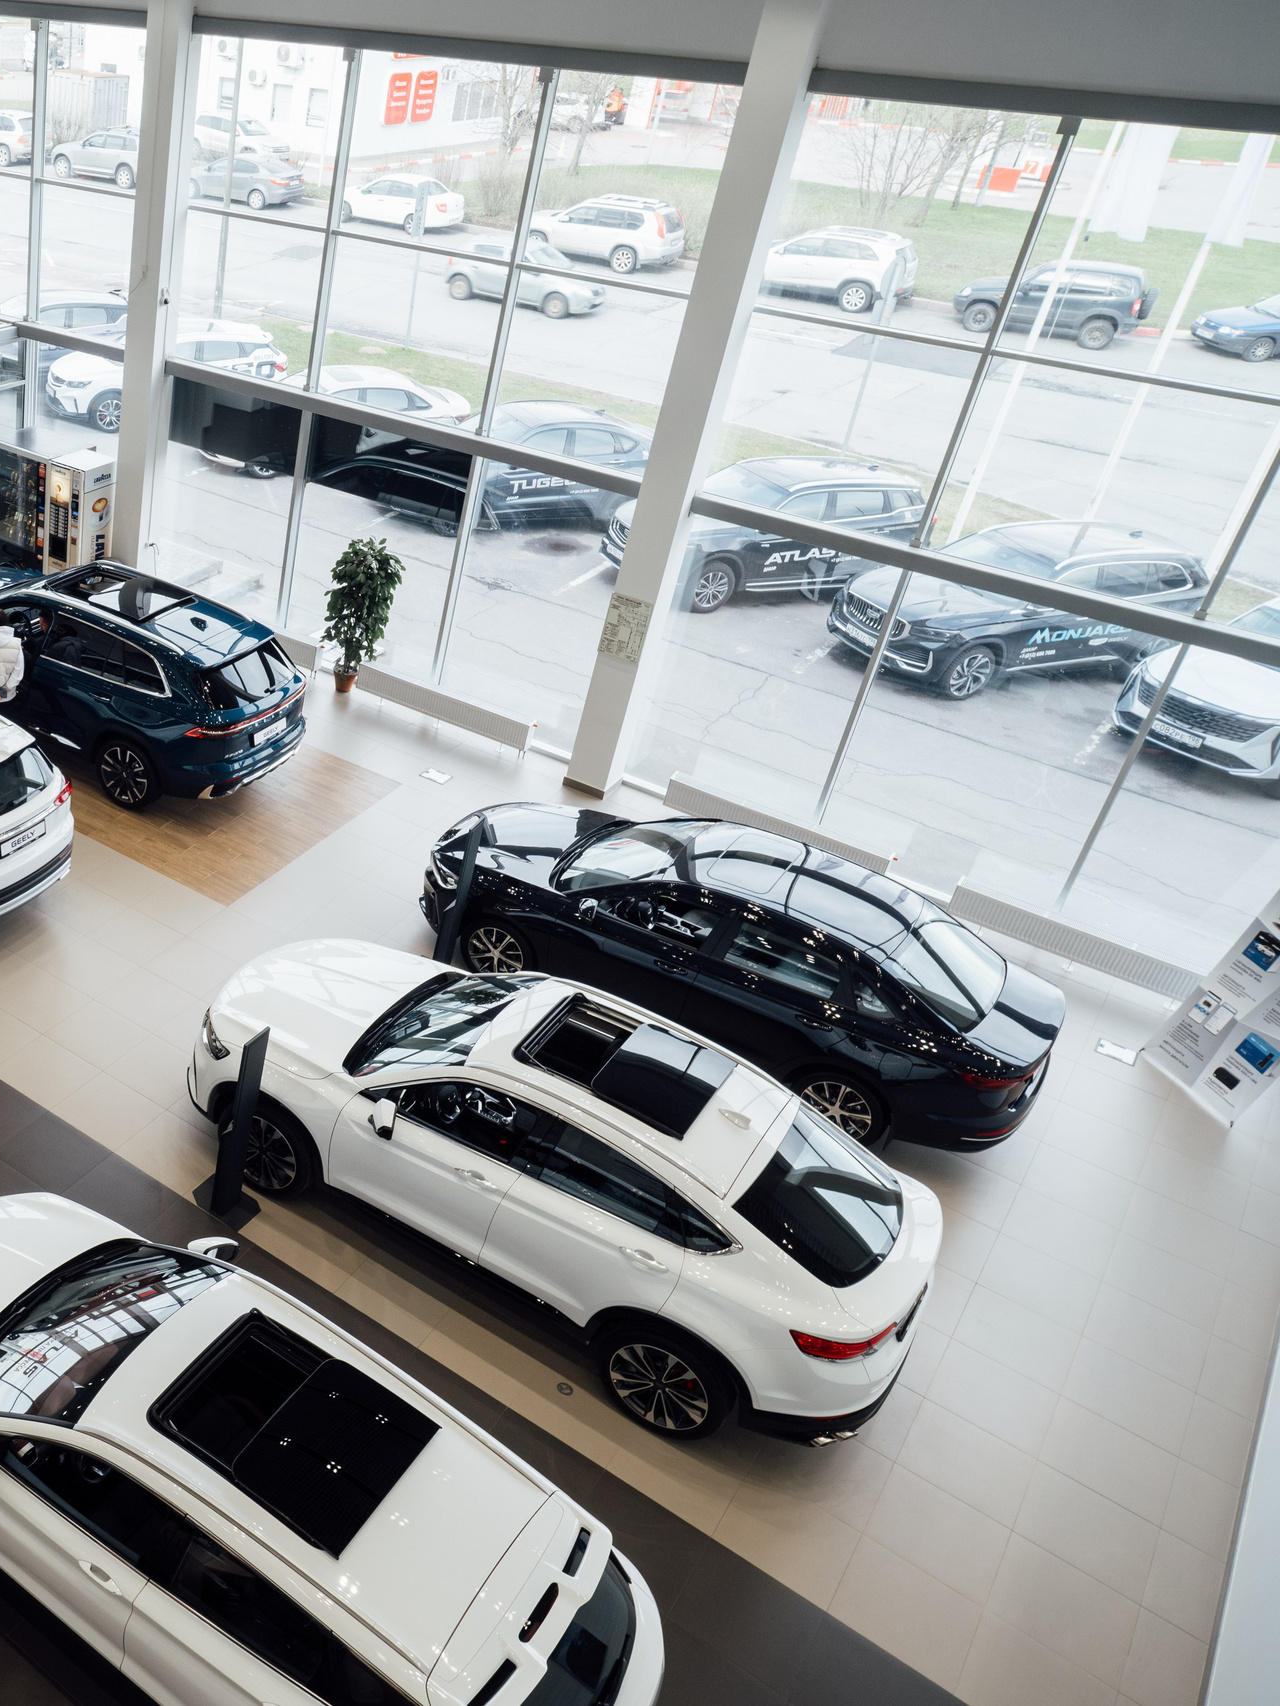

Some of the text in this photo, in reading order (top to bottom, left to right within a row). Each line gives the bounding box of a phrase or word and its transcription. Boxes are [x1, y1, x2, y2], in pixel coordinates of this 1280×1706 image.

[510, 476, 580, 495] TUGEL
[763, 547, 837, 566] ATLAS
[263, 725, 279, 738] GEELY
[11, 829, 36, 848] GEELY
